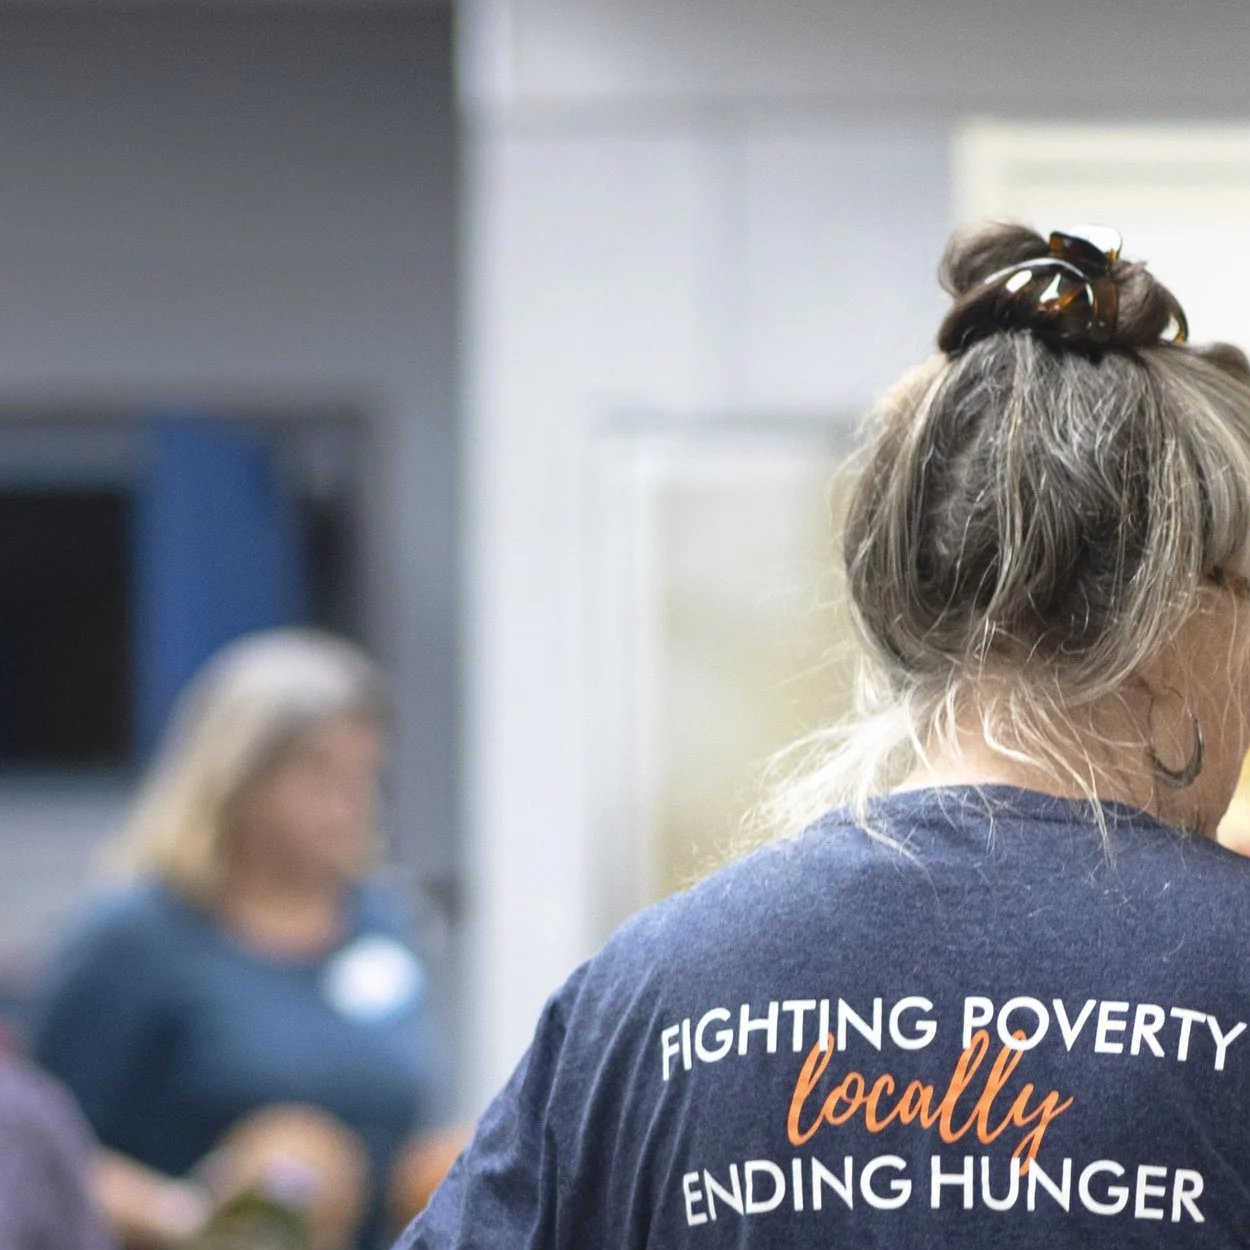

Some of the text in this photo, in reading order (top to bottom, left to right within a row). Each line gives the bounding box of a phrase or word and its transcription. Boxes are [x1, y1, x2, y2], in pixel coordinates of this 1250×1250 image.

[661, 996, 1247, 1081] FIGHTING POVERTY
[787, 1029, 1073, 1177] locally
[682, 1155, 1206, 1227] ENDING HUNGER
